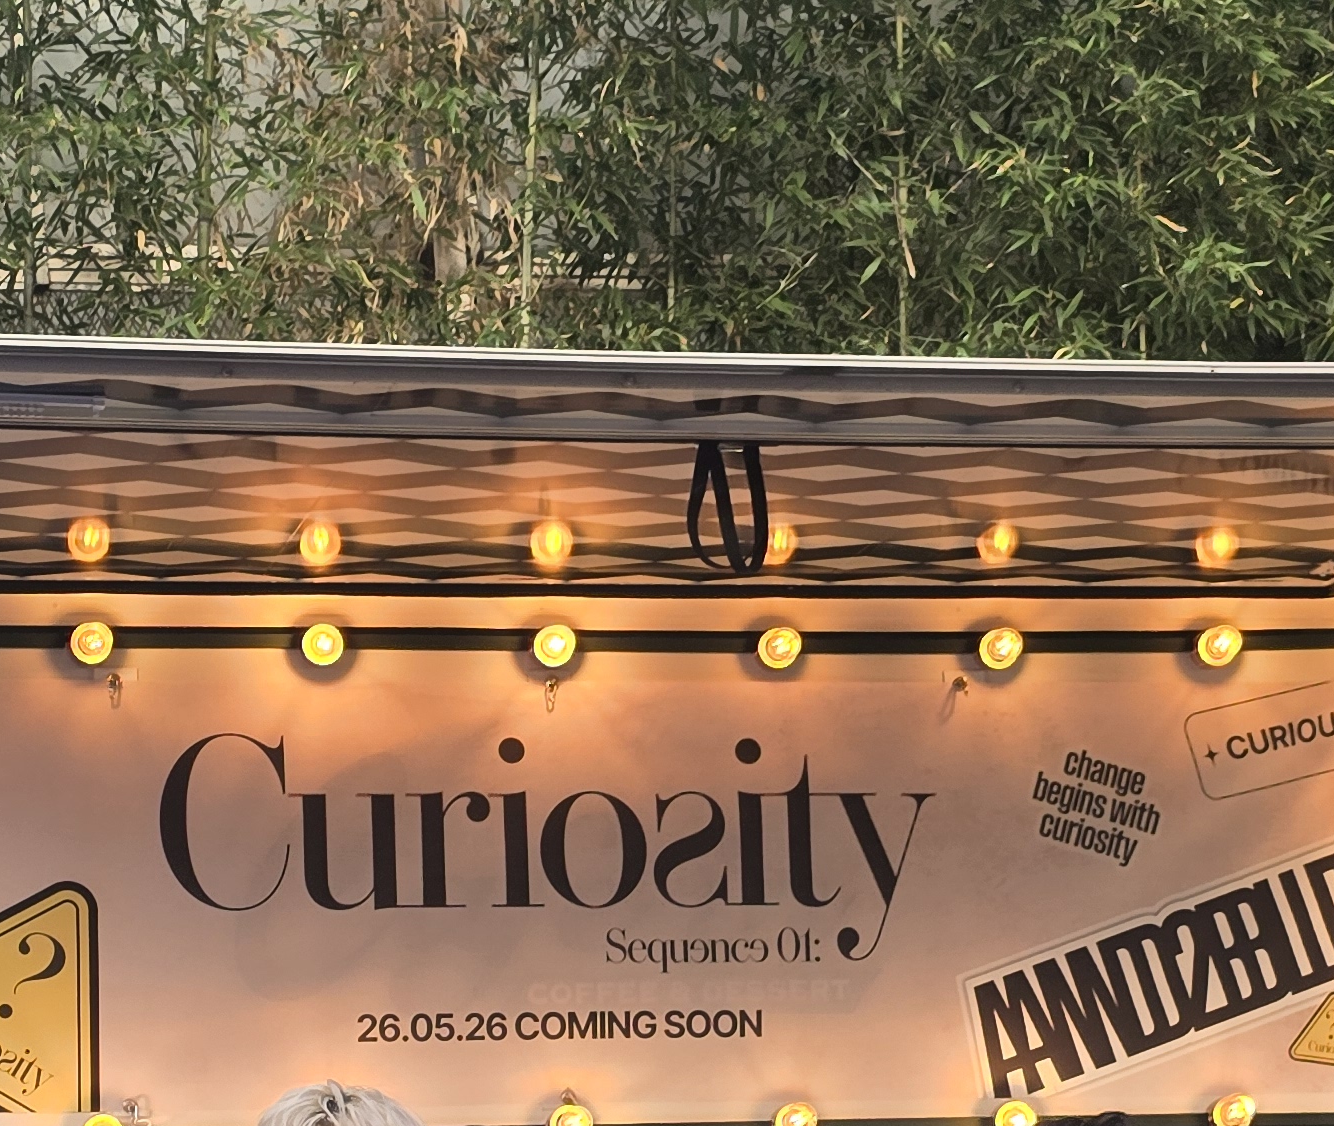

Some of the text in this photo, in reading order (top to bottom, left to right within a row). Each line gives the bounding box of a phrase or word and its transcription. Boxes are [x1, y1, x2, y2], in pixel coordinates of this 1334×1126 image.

[1063, 750, 1146, 797] change
[1032, 771, 1161, 835] begins with
[158, 733, 936, 962] Curiosity
[1038, 812, 1138, 867] curiosity
[775, 926, 822, 963] 01:
[357, 1009, 763, 1043] 26.05.26 COMING SOON
